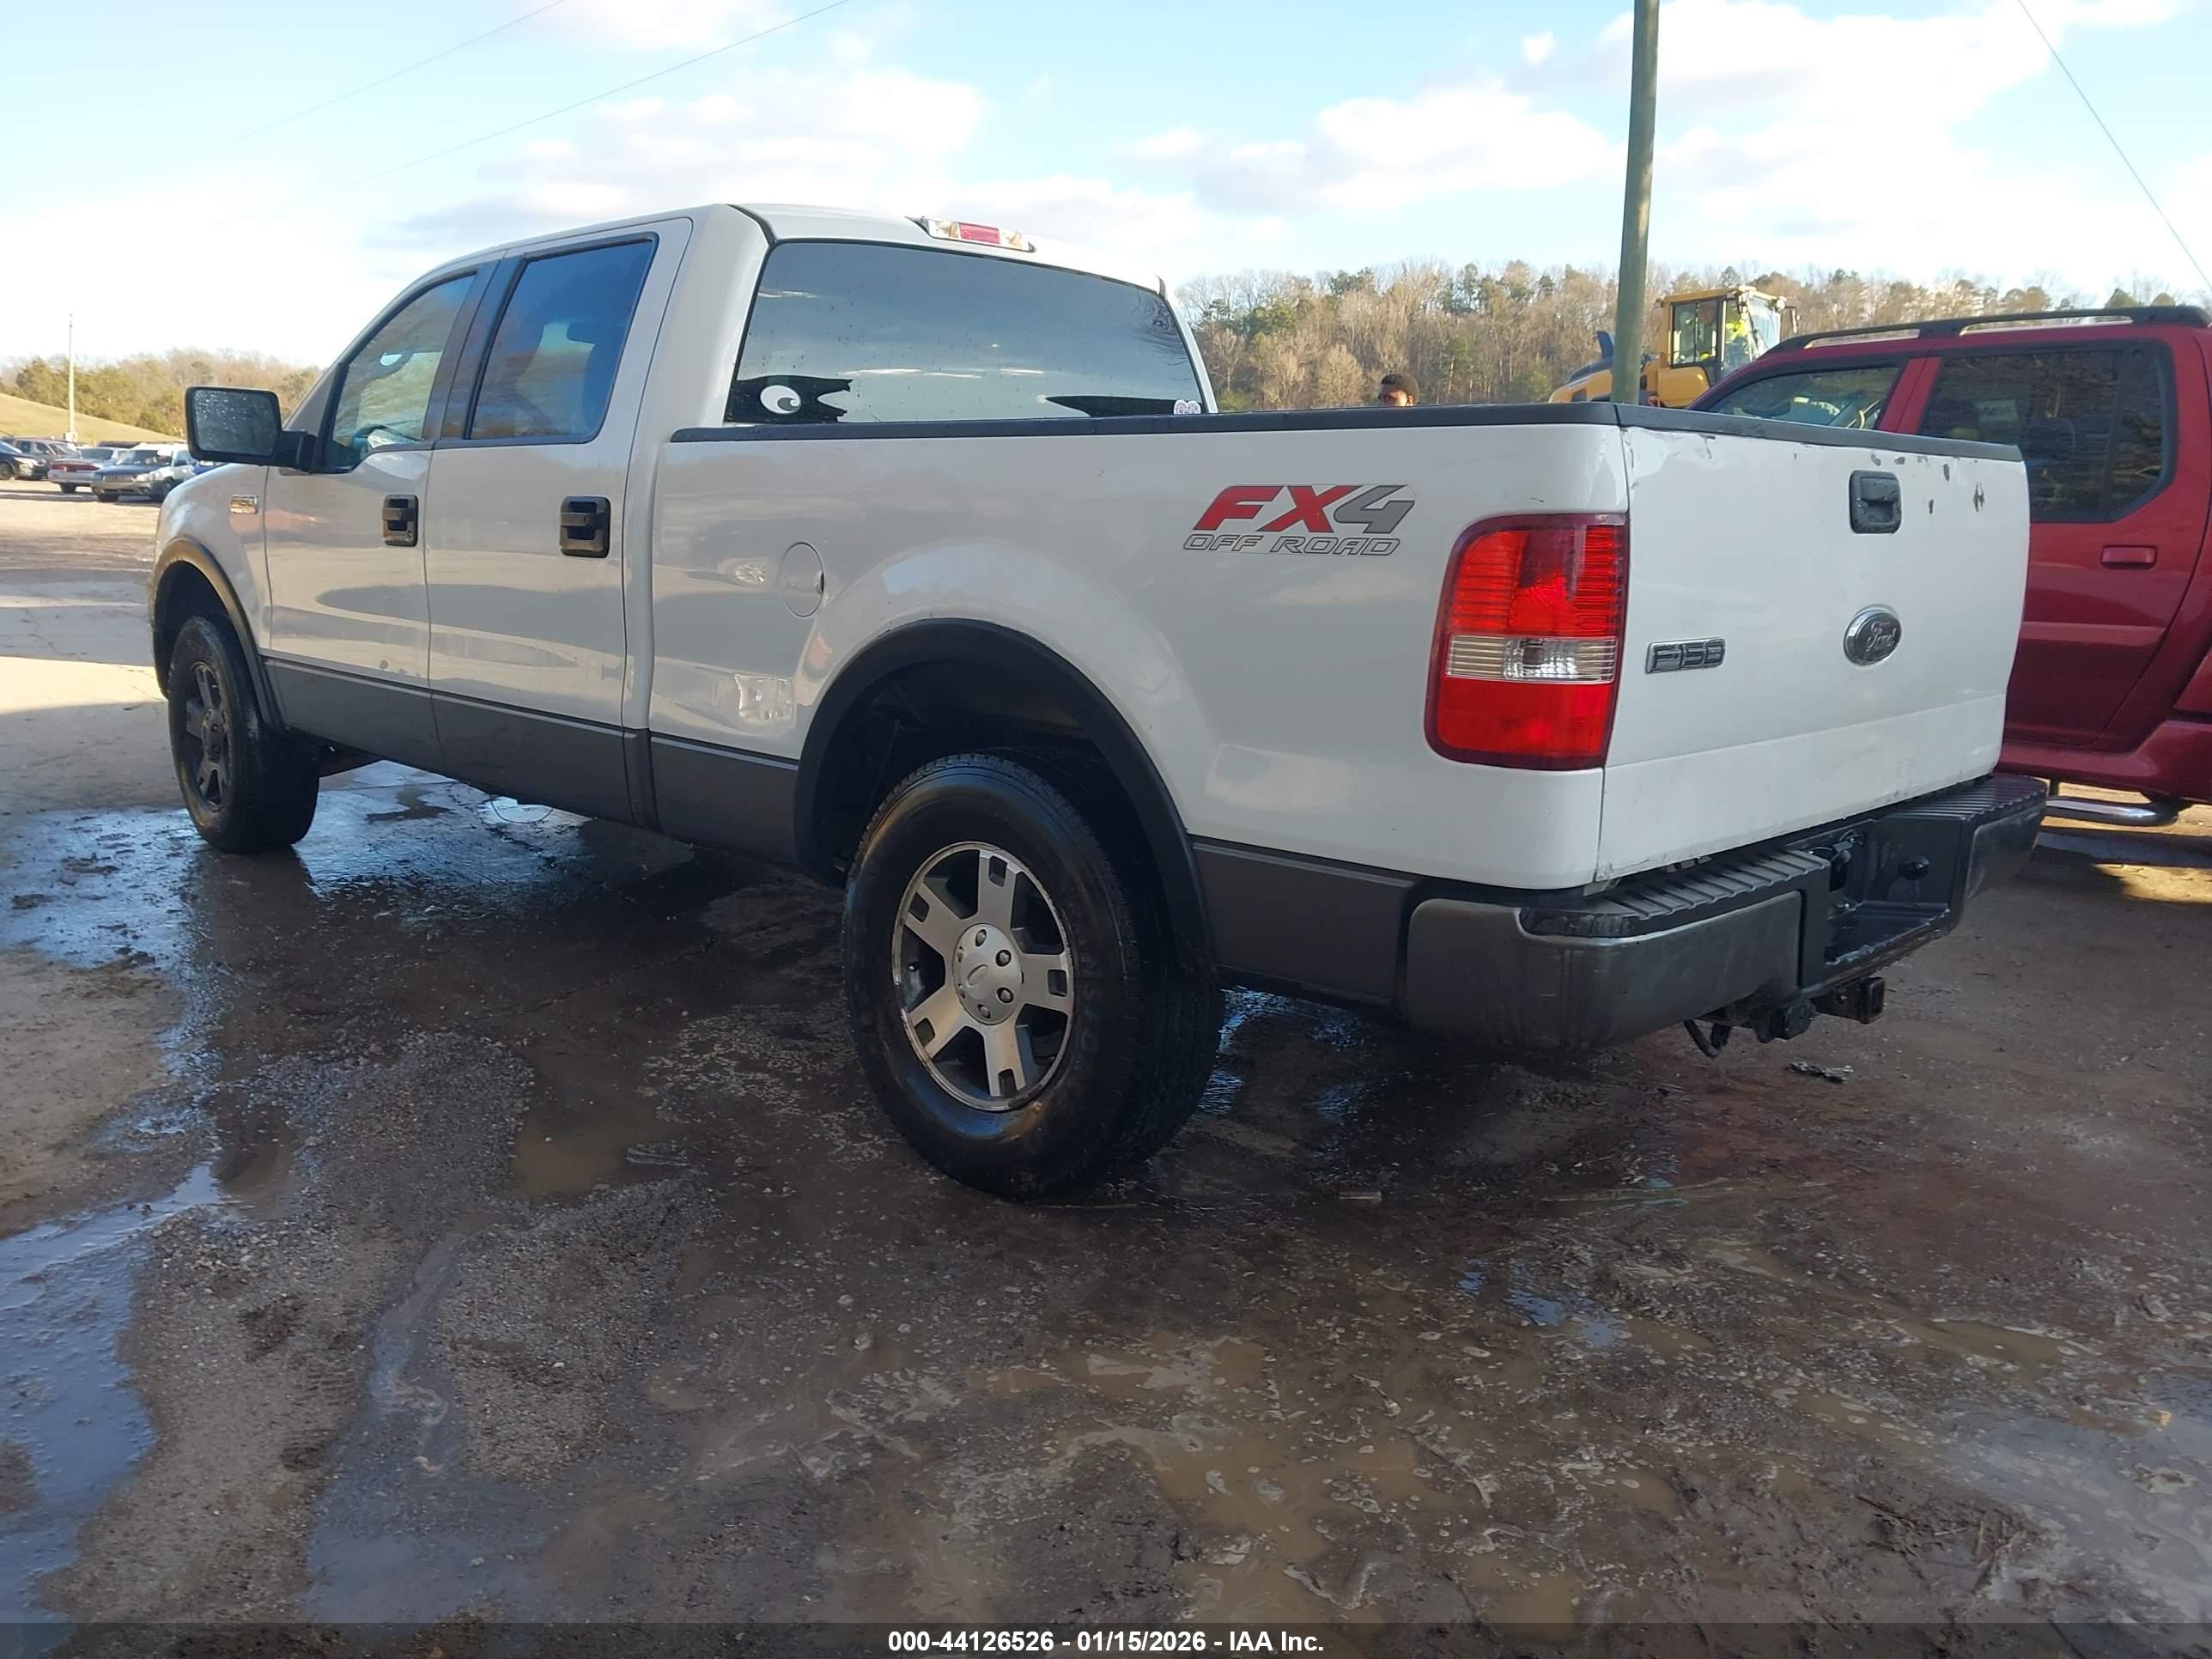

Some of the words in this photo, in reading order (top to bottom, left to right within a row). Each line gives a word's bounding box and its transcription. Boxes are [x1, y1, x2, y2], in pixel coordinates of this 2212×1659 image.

[1193, 485, 1415, 534] FX4
[1184, 534, 1264, 550] OFF
[1270, 537, 1401, 556] ROAD
